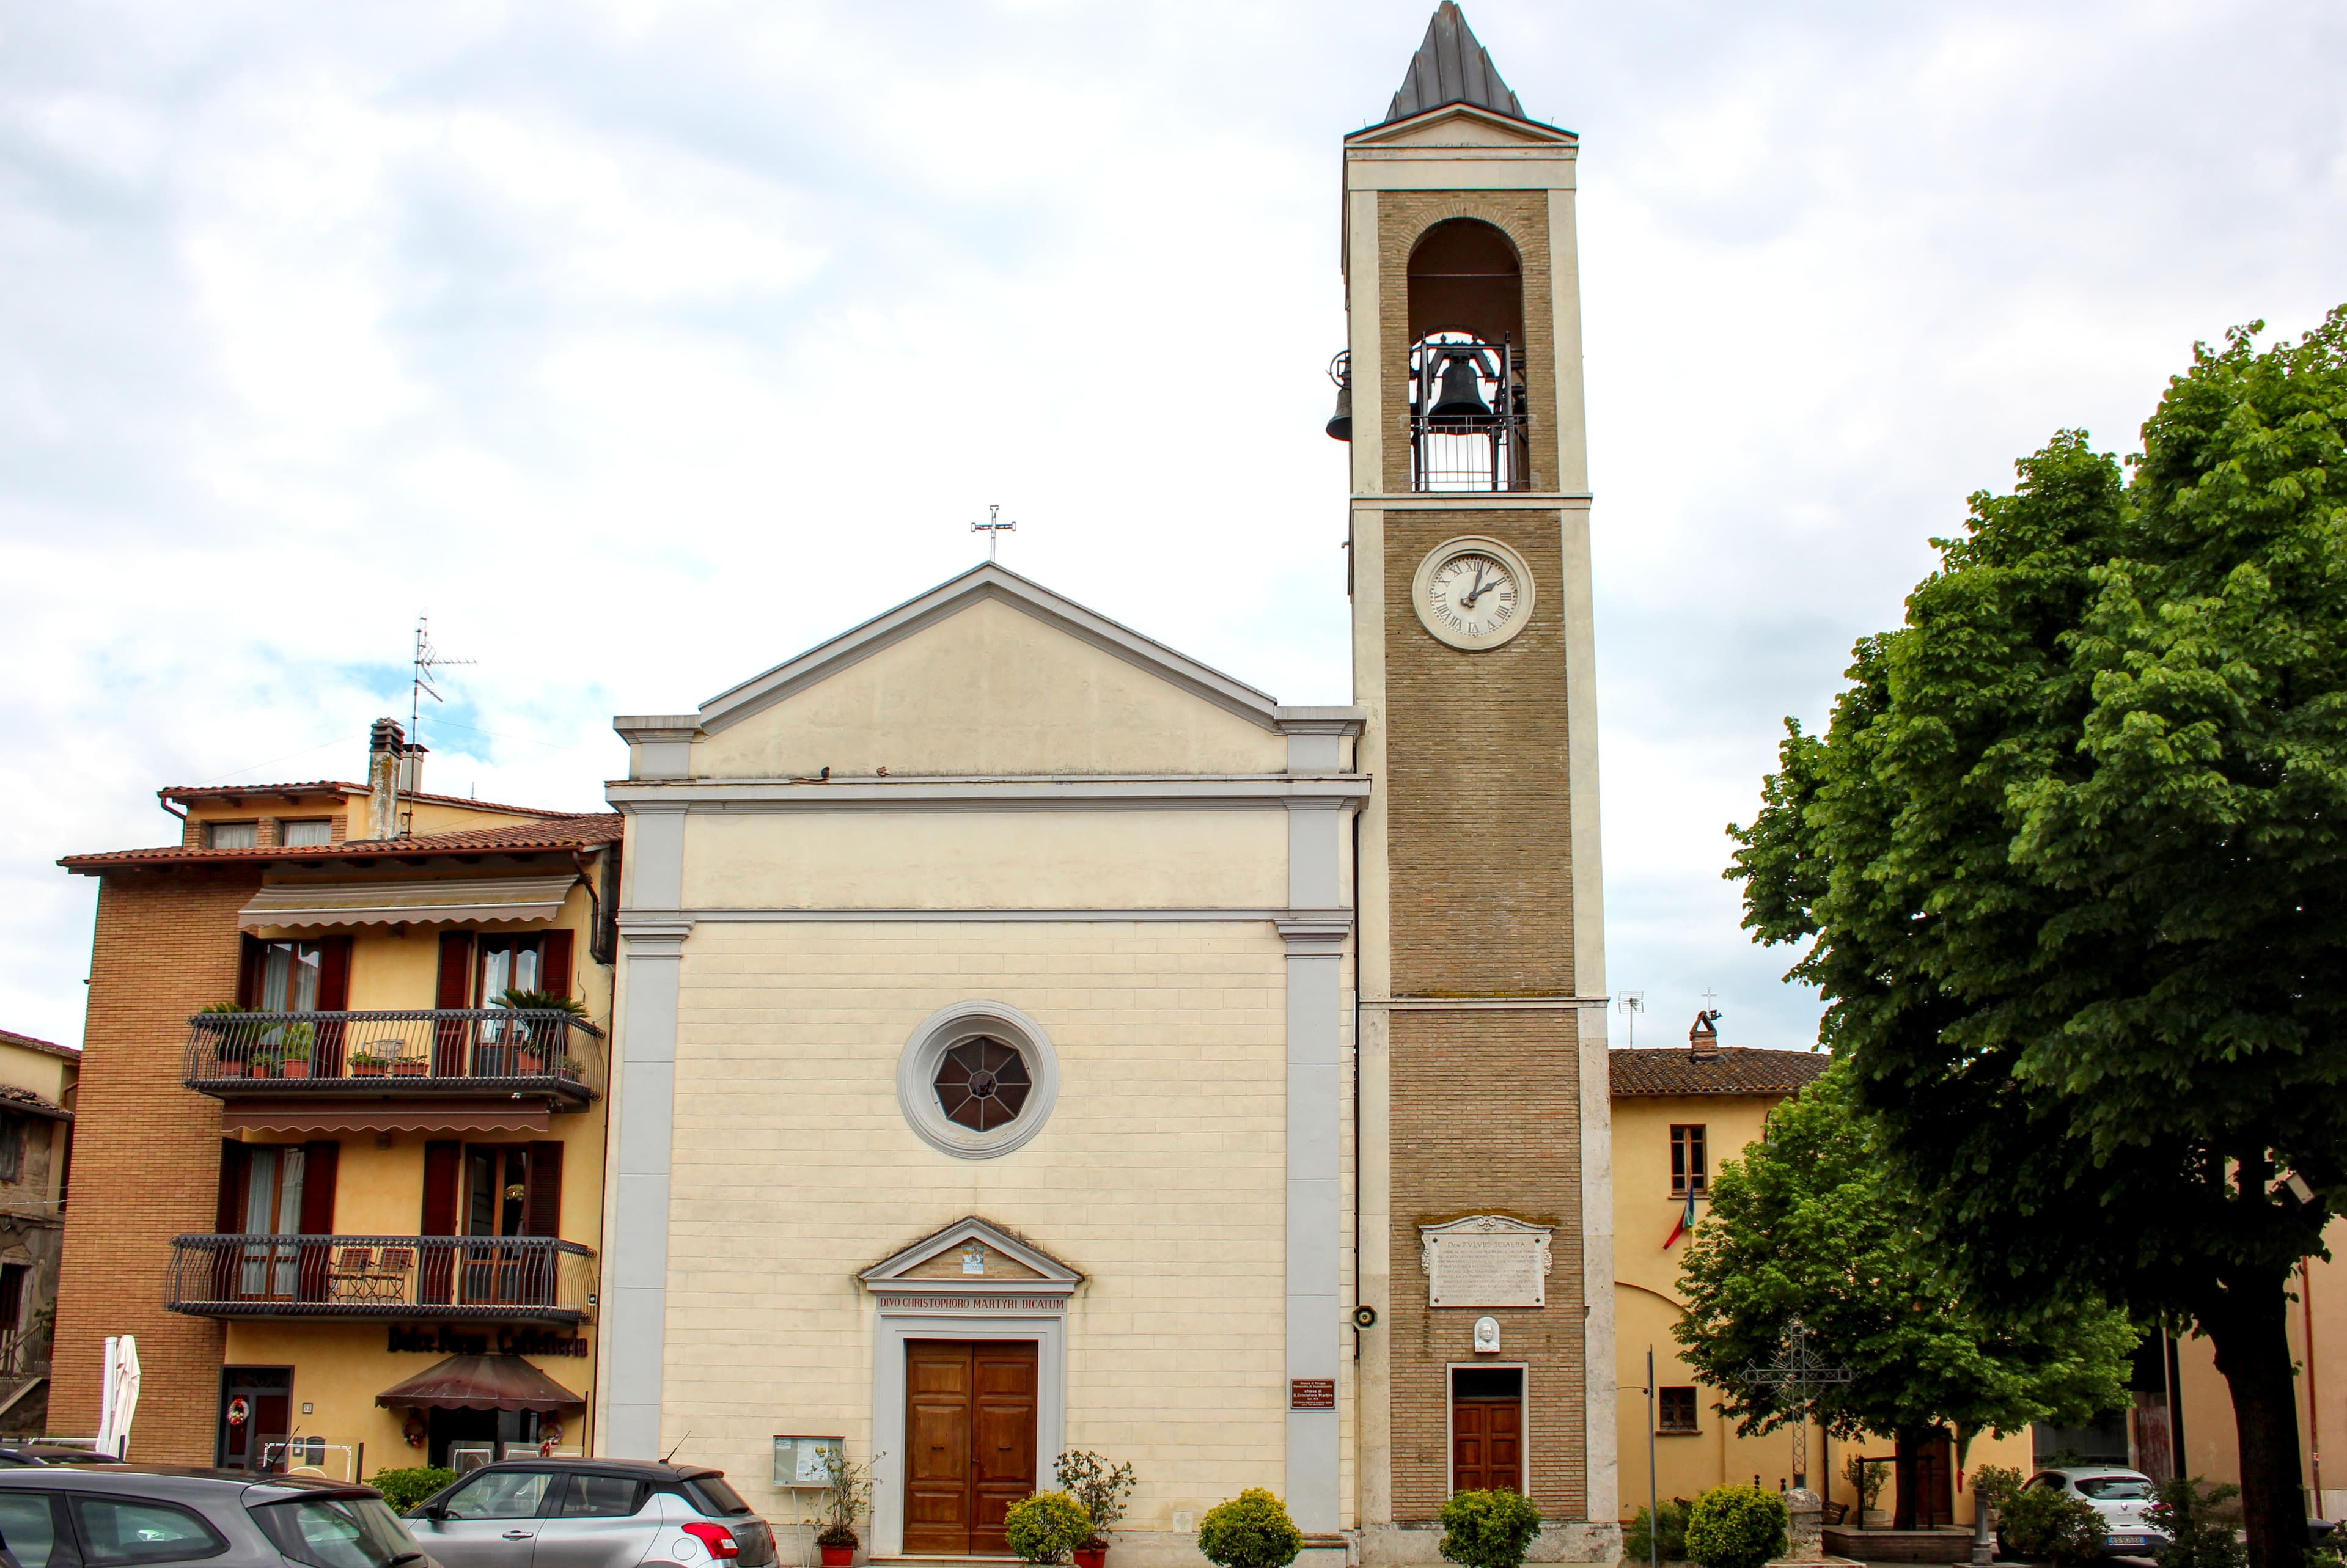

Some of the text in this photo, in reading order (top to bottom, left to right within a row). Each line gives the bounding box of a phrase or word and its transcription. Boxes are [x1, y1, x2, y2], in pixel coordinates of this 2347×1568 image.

[1449, 564, 1463, 577] XI
[1485, 566, 1493, 576] I
[1438, 576, 1451, 587] X
[1500, 592, 1512, 601] III
[880, 1297, 1063, 1310] DIVO CHRISTOPHORO MARTYRI DICATUM
